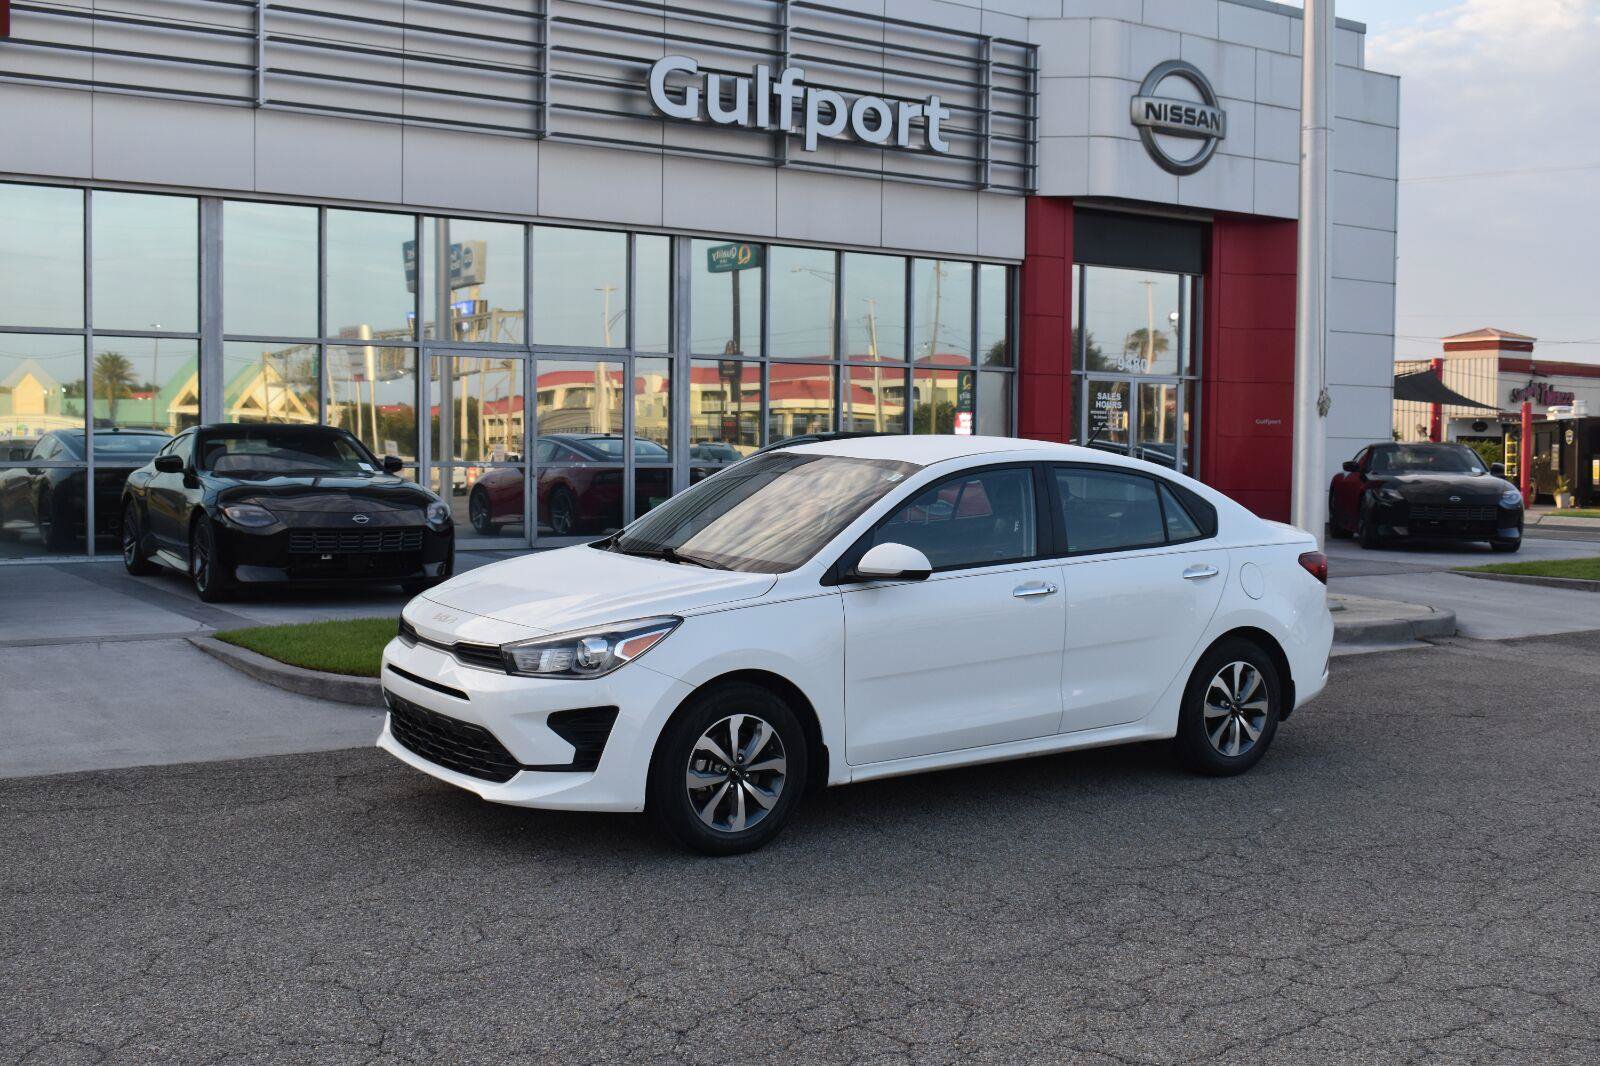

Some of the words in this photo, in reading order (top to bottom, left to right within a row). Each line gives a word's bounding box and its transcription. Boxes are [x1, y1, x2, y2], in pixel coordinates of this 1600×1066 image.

[647, 54, 951, 153] Gulfport
[1144, 101, 1221, 132] NISSAN
[1097, 392, 1122, 401] SALES
[1095, 400, 1123, 409] HOURS
[1255, 417, 1282, 425] Gulfport
